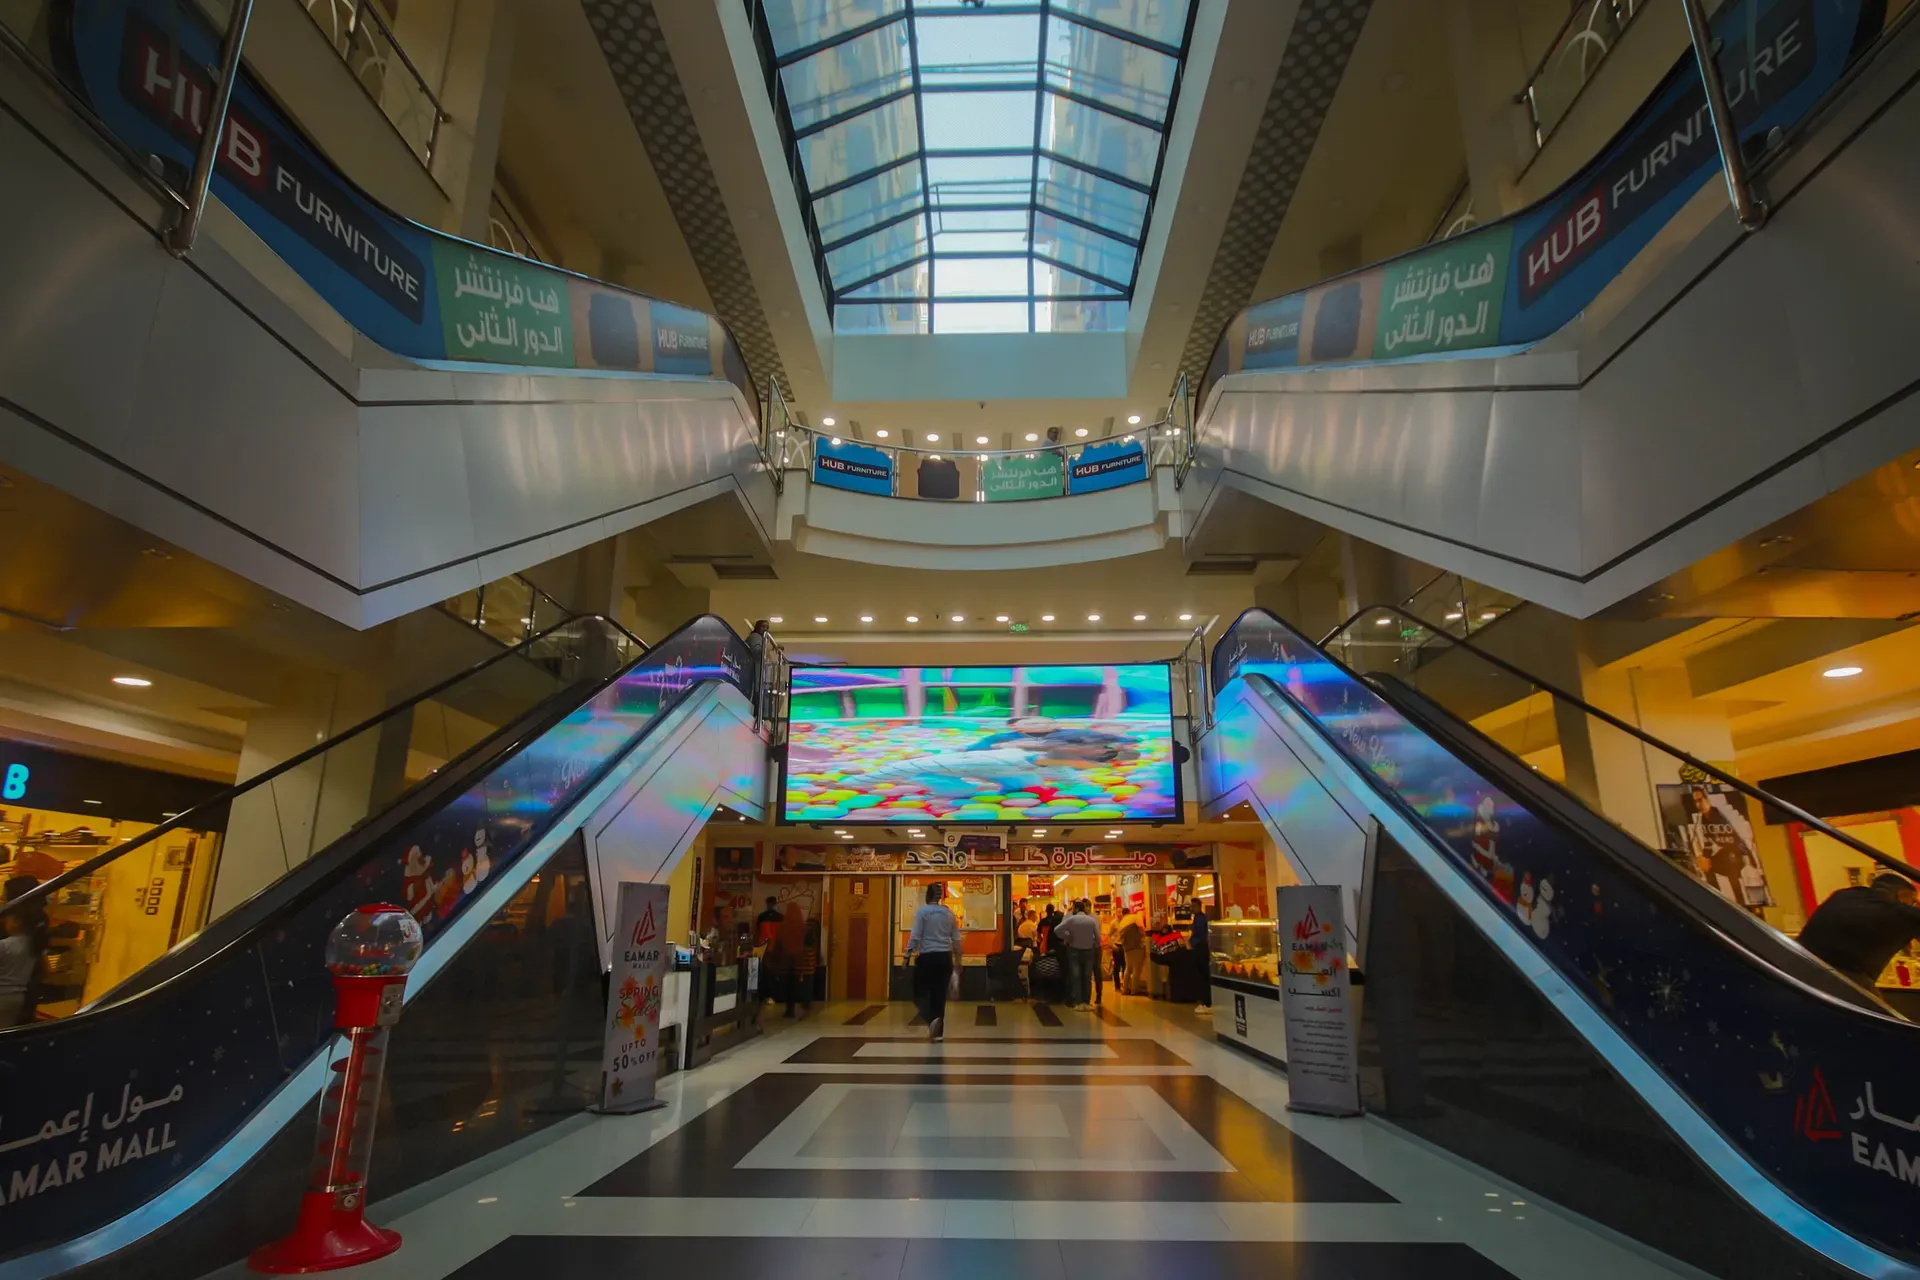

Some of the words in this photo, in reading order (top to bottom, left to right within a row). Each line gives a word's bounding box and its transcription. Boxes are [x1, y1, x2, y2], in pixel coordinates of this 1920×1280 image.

[1527, 195, 1602, 288] HUB
[1611, 17, 1803, 210] FURNIURE
[275, 165, 420, 303] FURNITURE
[454, 254, 524, 309] فرنتشر
[1390, 262, 1450, 311] فرنتشر
[1454, 252, 1495, 296] هب
[527, 286, 560, 316] هب
[1248, 327, 1266, 347] HUB
[1434, 300, 1490, 346] الدور
[523, 325, 564, 356] الدور
[657, 328, 678, 350] HUB
[821, 458, 845, 471] HUB
[846, 464, 888, 477] FURNITURE
[1076, 464, 1100, 476] HUB
[1101, 455, 1142, 470] FURNITURE
[2, 763, 30, 800] B
[904, 847, 968, 870] واحد
[1052, 847, 1157, 869] مبادرة
[624, 950, 660, 962] EAMAR
[619, 985, 659, 999] SPRING
[101, 1083, 185, 1131] مول
[96, 1122, 177, 1174] MALL
